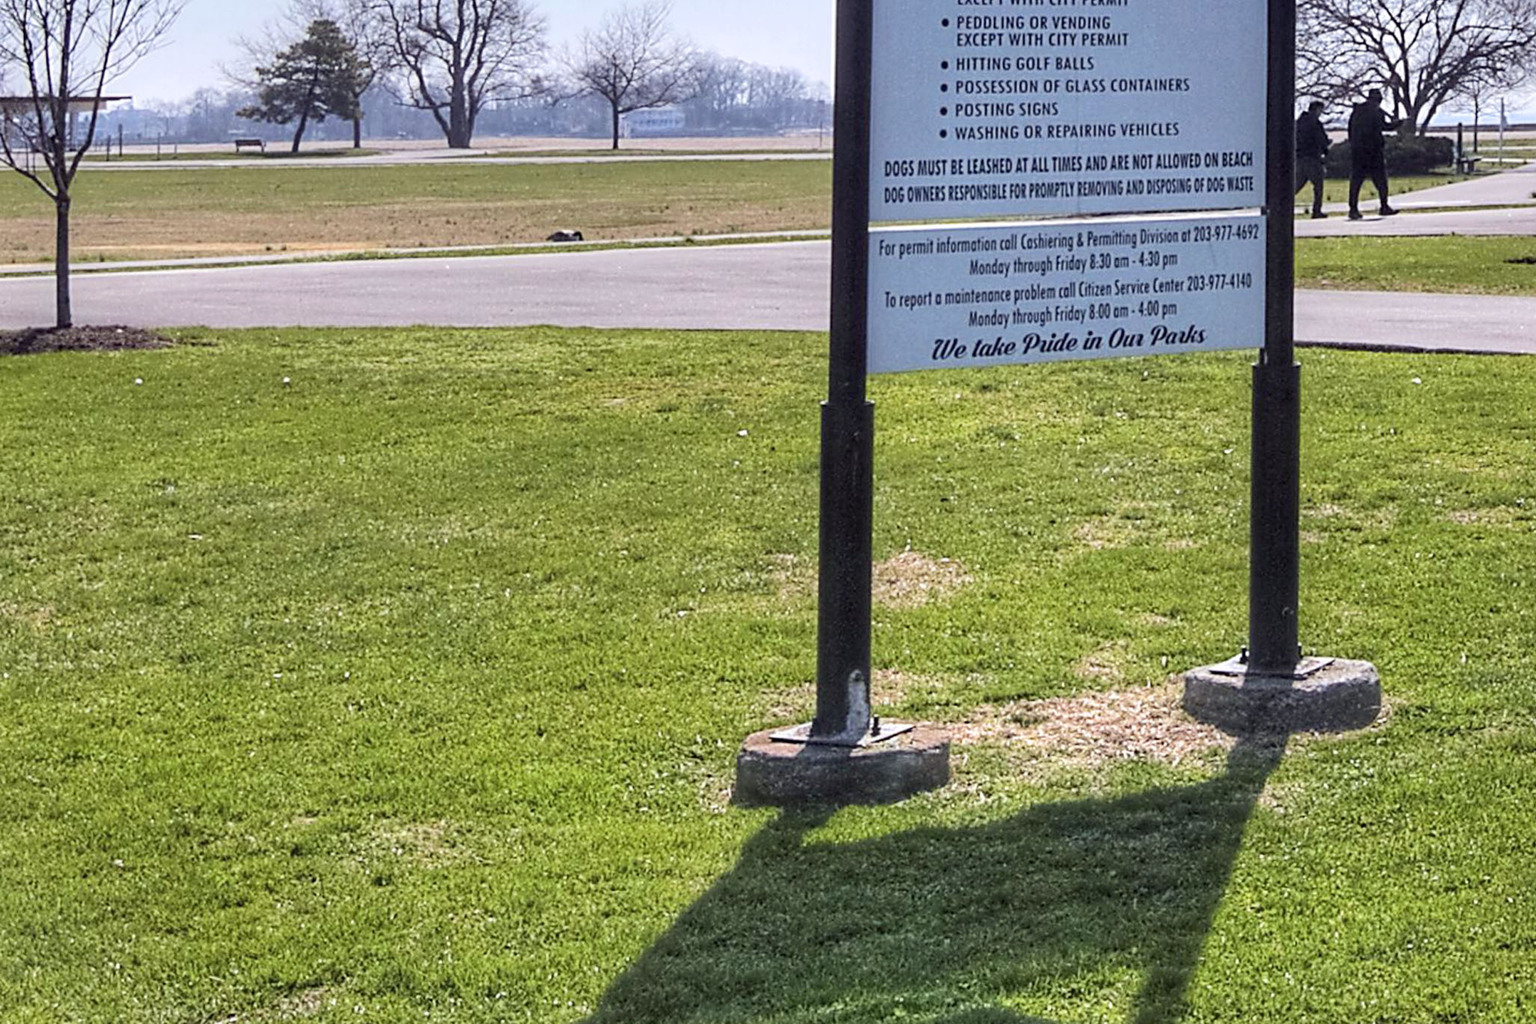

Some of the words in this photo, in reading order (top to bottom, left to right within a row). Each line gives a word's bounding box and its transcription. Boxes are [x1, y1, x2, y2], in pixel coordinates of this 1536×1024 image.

[957, 16, 1024, 29] PEDDLING
[1030, 16, 1047, 29] OR
[1052, 16, 1110, 29] VENDING
[957, 33, 1003, 46] EXCEPT
[1009, 33, 1043, 46] WITH
[1049, 33, 1076, 46] CITY
[1082, 33, 1128, 46] PERMIT
[957, 57, 1011, 70] HITTING
[1016, 57, 1049, 70] GOLF
[1056, 57, 1094, 70] BALLS
[956, 80, 1038, 94] POSSESSION
[1044, 80, 1059, 93] OF
[1066, 79, 1105, 92] GLASS
[1111, 78, 1189, 92] CONTAINERS
[956, 103, 1014, 117] POSTING
[1019, 102, 1058, 116] SIGNS
[955, 126, 1019, 140] WASHING
[1024, 125, 1041, 138] OR
[1048, 124, 1116, 138] REPAIRING
[1121, 122, 1179, 136] VEHICLES
[885, 160, 914, 177] DOGS
[918, 160, 947, 176] MUST
[951, 159, 963, 175] BE
[968, 158, 1012, 174] LEASHED
[1016, 157, 1028, 173] AT
[1031, 157, 1049, 172] ALL
[1052, 156, 1082, 172] TIMES
[1086, 156, 1107, 170] AND
[1110, 155, 1129, 170] ARE
[1133, 154, 1153, 169] NOT
[1156, 153, 1201, 169] ALLOWED
[1204, 153, 1218, 168] ON
[1222, 152, 1252, 167] BEACH
[885, 187, 904, 203] DOG
[907, 186, 945, 202] OWNERS
[949, 184, 1006, 201] RESPONSIBLE
[1010, 183, 1026, 199] FOR
[1029, 182, 1074, 198] PROMPTLY
[1078, 180, 1123, 196] REMOVING
[1126, 180, 1144, 194] AND
[1147, 178, 1191, 194] DISPOSING
[1194, 178, 1204, 193] OF
[1207, 177, 1224, 192] DOG
[1227, 176, 1253, 191] WASTE
[879, 239, 896, 256] For
[899, 240, 933, 259] permit
[937, 236, 996, 253] information
[1000, 234, 1017, 250] call
[1021, 233, 1073, 252] Cashiering
[1077, 233, 1083, 247] &
[1087, 231, 1137, 249] Permitting
[1140, 229, 1178, 244] Division
[1181, 229, 1191, 242] at
[1194, 224, 1259, 242] 203-977-4692
[970, 259, 1010, 277] Monday
[1014, 256, 1052, 276] through
[1056, 255, 1087, 274] Friday
[1090, 253, 1111, 269] 8:30
[1114, 257, 1129, 268] am
[1139, 251, 1160, 267] 4:30
[1163, 255, 1177, 270] pm
[885, 291, 896, 308] To
[900, 292, 932, 311] report
[935, 294, 941, 305] a
[945, 290, 1011, 304] maintenance
[1014, 284, 1055, 305] problem
[1059, 282, 1075, 298] call
[1079, 281, 1111, 297] Citizen
[1115, 279, 1150, 295] Service
[1153, 277, 1184, 293] Center
[1187, 273, 1252, 291] 203-977-4140
[969, 309, 1009, 329] Monday
[1013, 306, 1052, 327] through
[1055, 305, 1086, 324] Friday
[1089, 303, 1110, 320] 8:00
[1114, 307, 1128, 318] am
[1138, 301, 1159, 316] 4:00
[1162, 304, 1177, 319] pm
[932, 338, 966, 360] We
[972, 337, 1016, 357] take
[1023, 333, 1077, 354] Pride
[1083, 331, 1102, 350] in
[1109, 328, 1145, 348] Our
[1151, 325, 1205, 345] Parks
